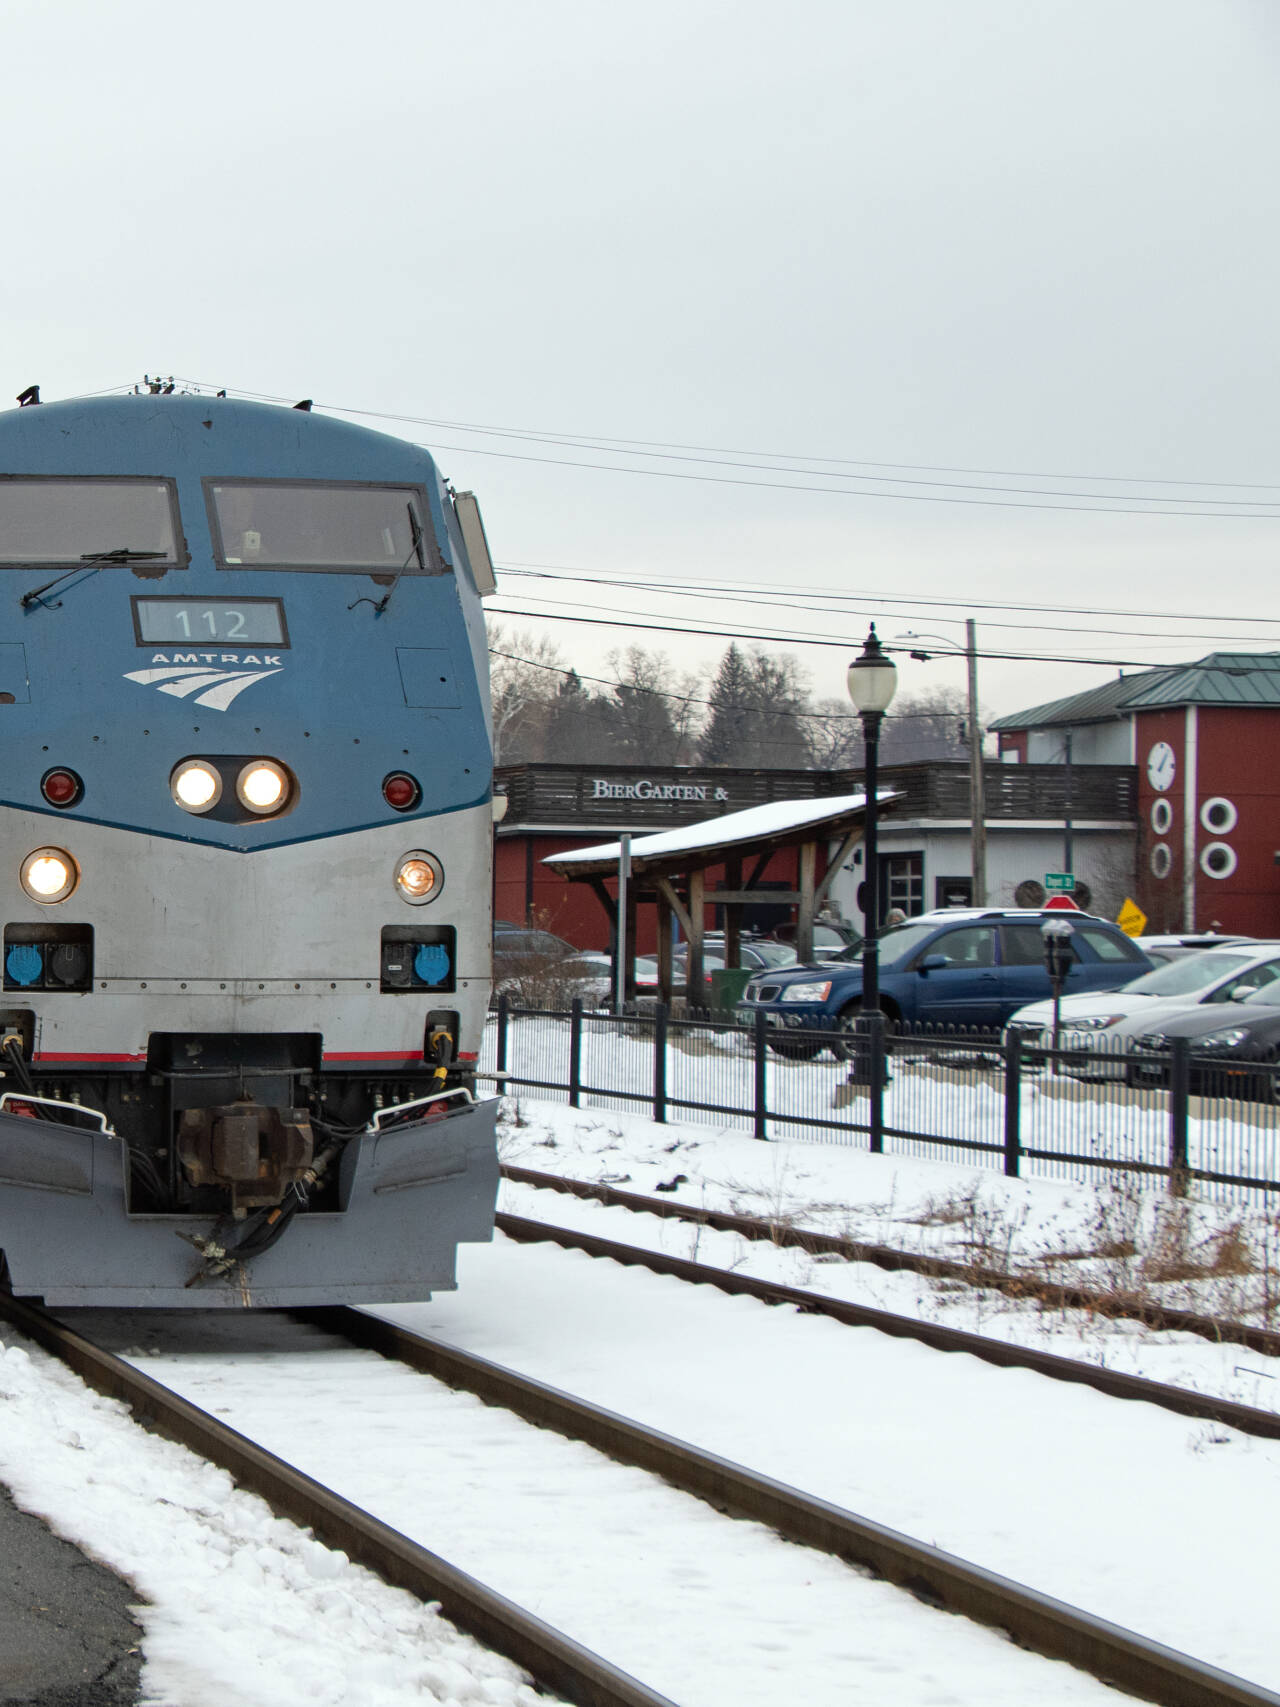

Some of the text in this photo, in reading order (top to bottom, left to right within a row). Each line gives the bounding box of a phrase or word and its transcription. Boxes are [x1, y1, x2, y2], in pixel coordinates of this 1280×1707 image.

[176, 610, 249, 639] 112
[152, 653, 283, 666] AMTRAK
[714, 787, 729, 800] &
